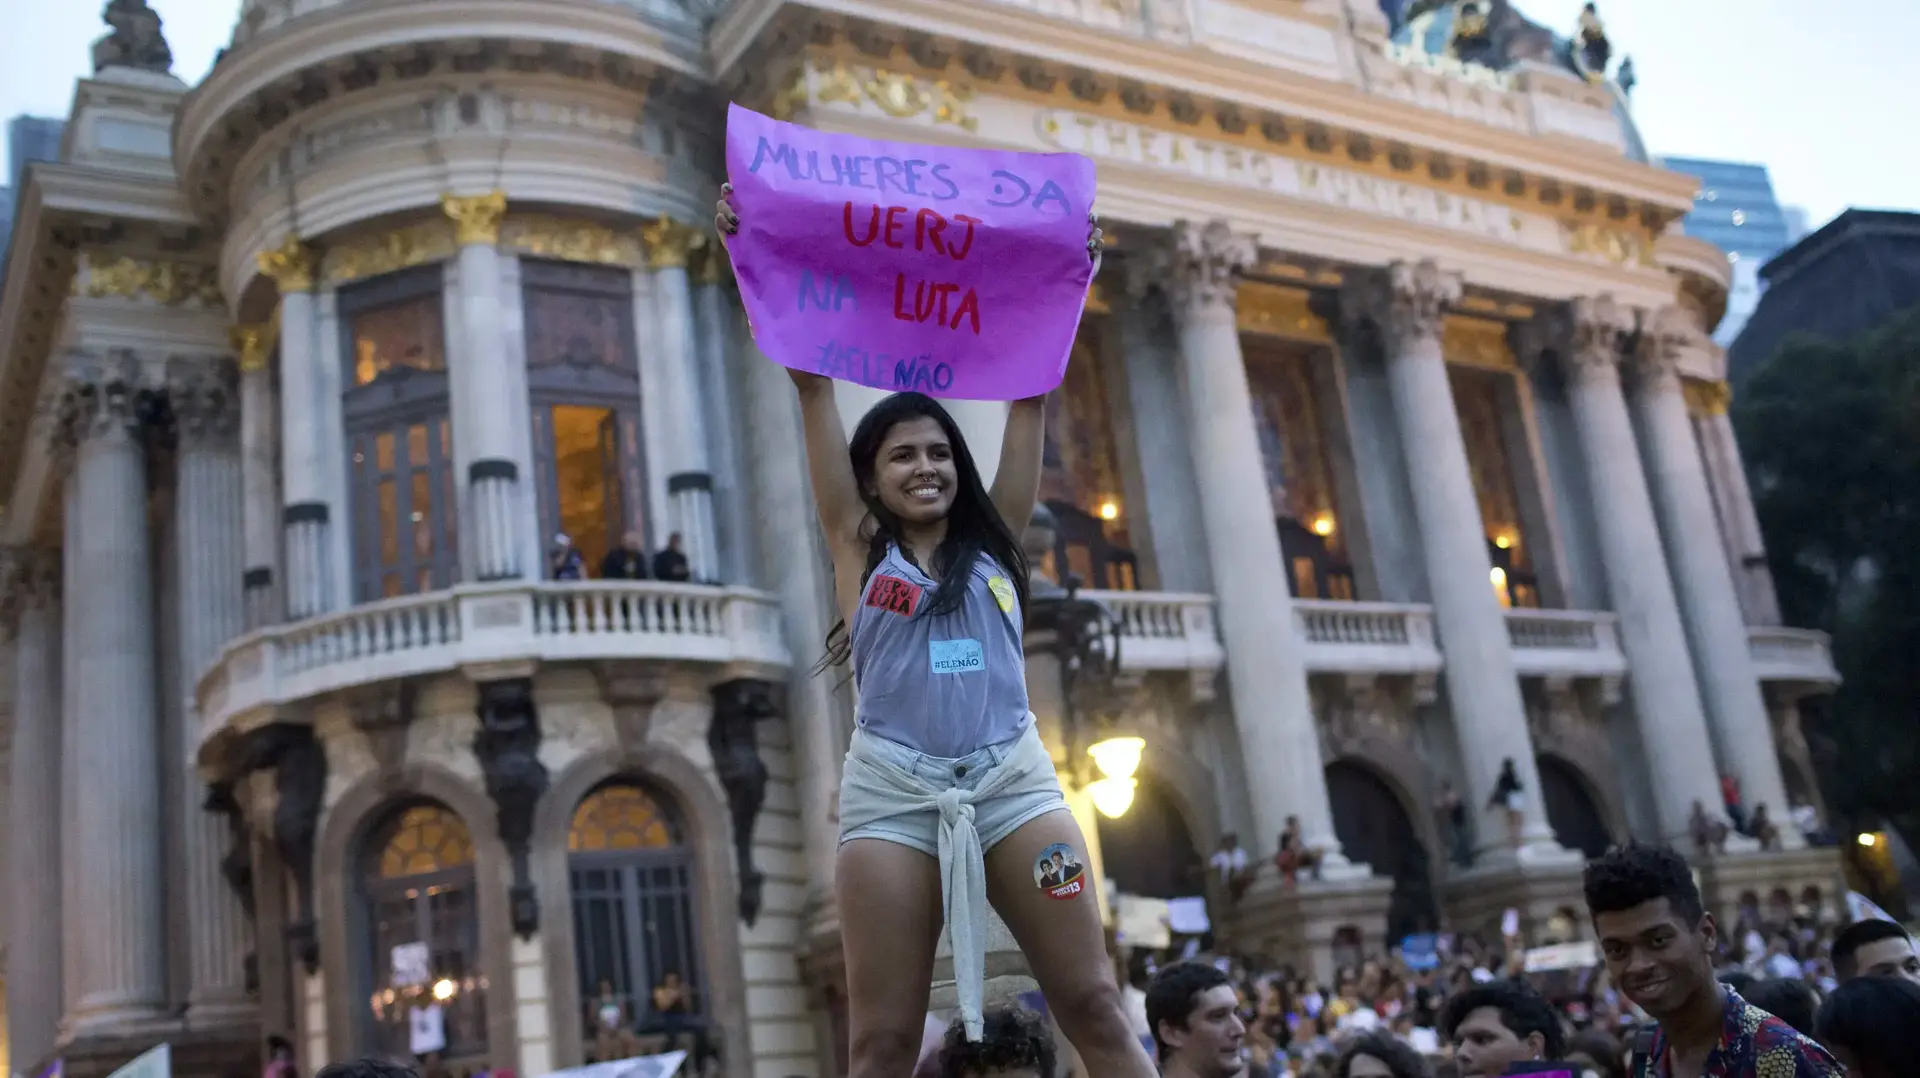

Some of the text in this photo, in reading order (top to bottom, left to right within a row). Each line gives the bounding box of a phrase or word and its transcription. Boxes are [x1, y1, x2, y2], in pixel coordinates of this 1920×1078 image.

[748, 136, 1072, 215] MULHERES DA
[843, 201, 982, 260] UERJ
[797, 268, 980, 335] NA LUTA
[817, 339, 954, 392] #ELENÃO
[866, 591, 910, 614] LULA
[1069, 881, 1081, 893] 13
